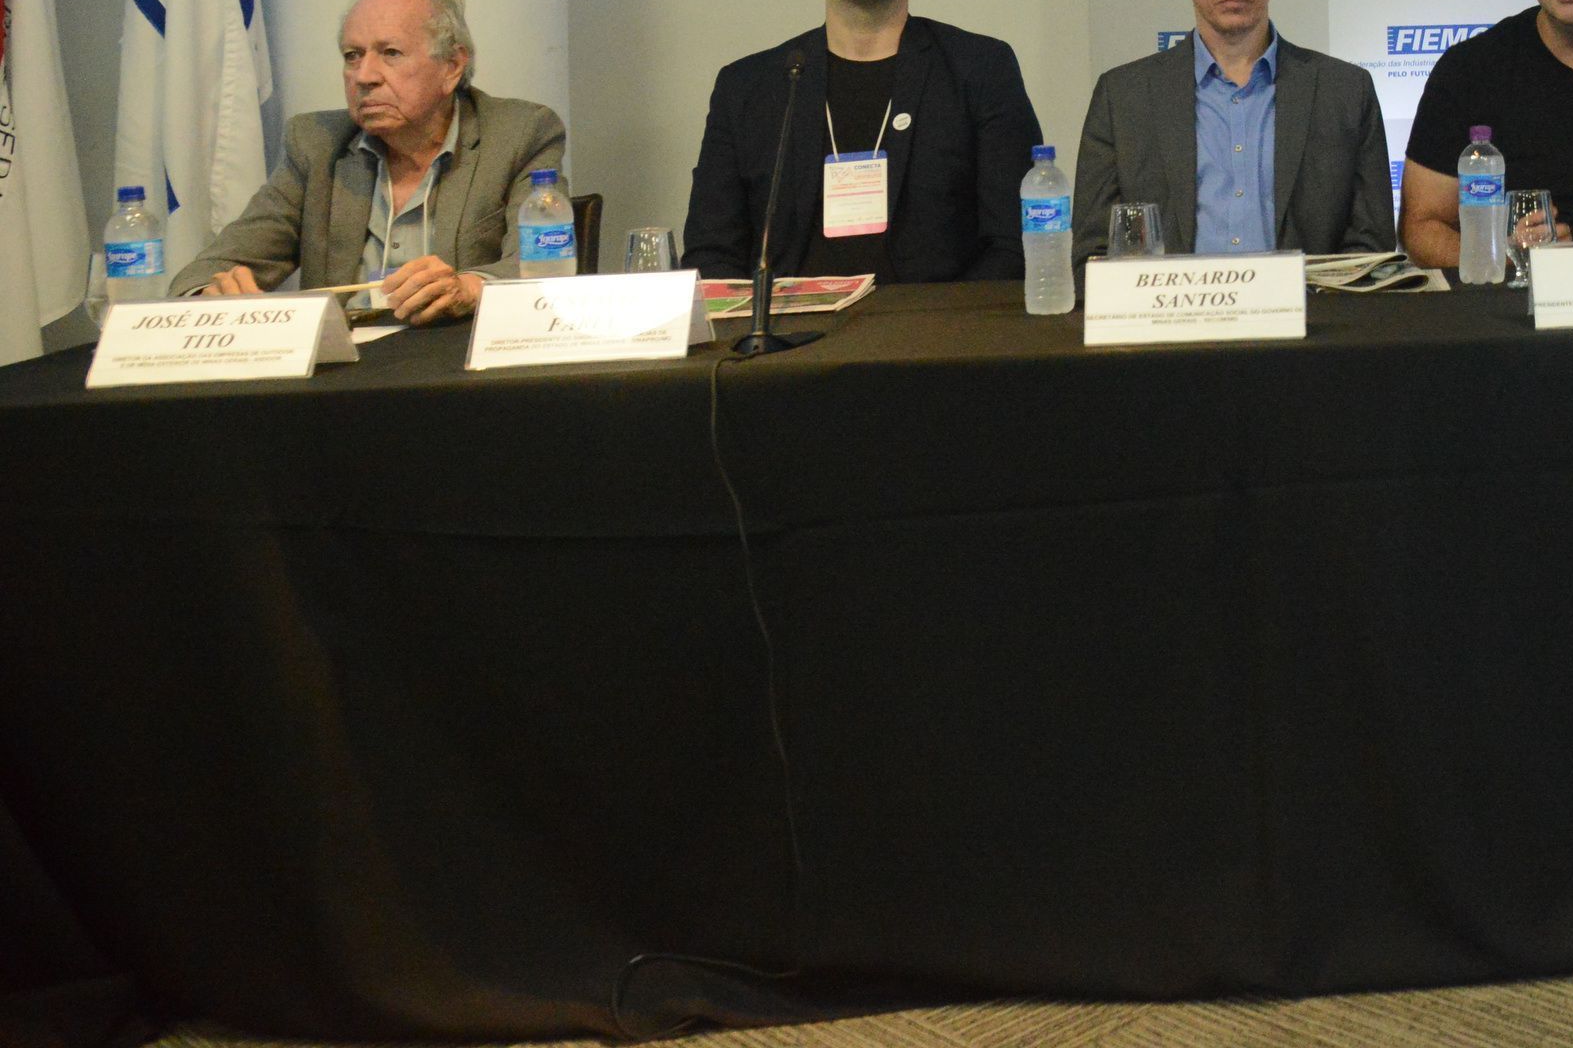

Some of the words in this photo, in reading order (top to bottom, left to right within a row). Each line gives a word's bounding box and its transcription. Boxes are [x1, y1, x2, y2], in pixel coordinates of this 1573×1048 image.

[1136, 268, 1256, 288] BERNARDO
[1152, 291, 1239, 309] SANTOS
[132, 310, 191, 330] JOSÉ
[194, 312, 228, 327] DE
[231, 309, 296, 325] ASSIS
[182, 333, 235, 350] TITO
